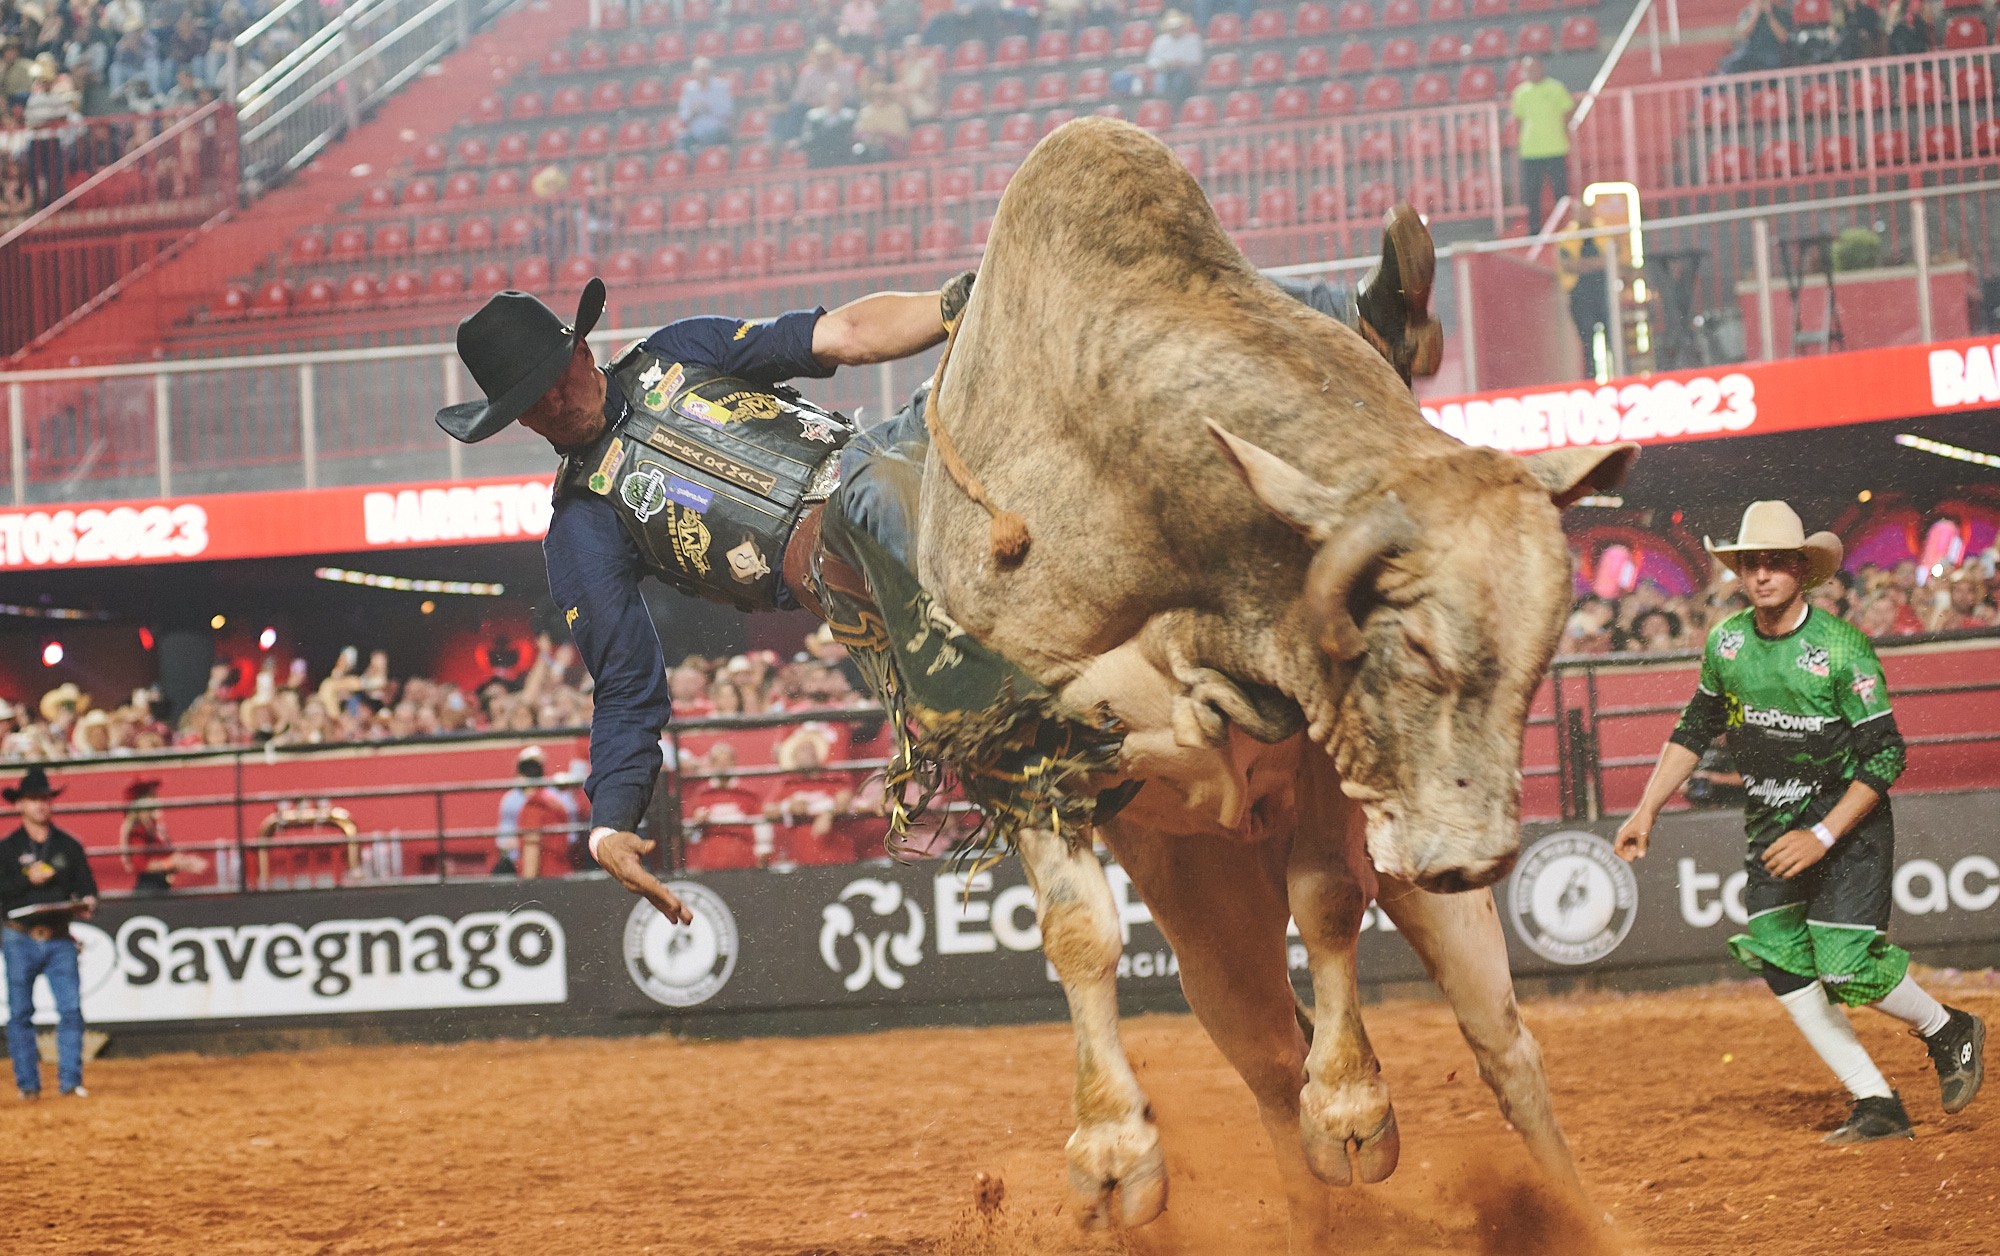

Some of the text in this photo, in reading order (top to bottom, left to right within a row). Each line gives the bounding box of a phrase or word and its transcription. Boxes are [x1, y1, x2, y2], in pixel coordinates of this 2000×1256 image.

[364, 479, 555, 545] BARRETO
[1743, 704, 1824, 732] EcoPower
[126, 922, 554, 997] Savegnago
